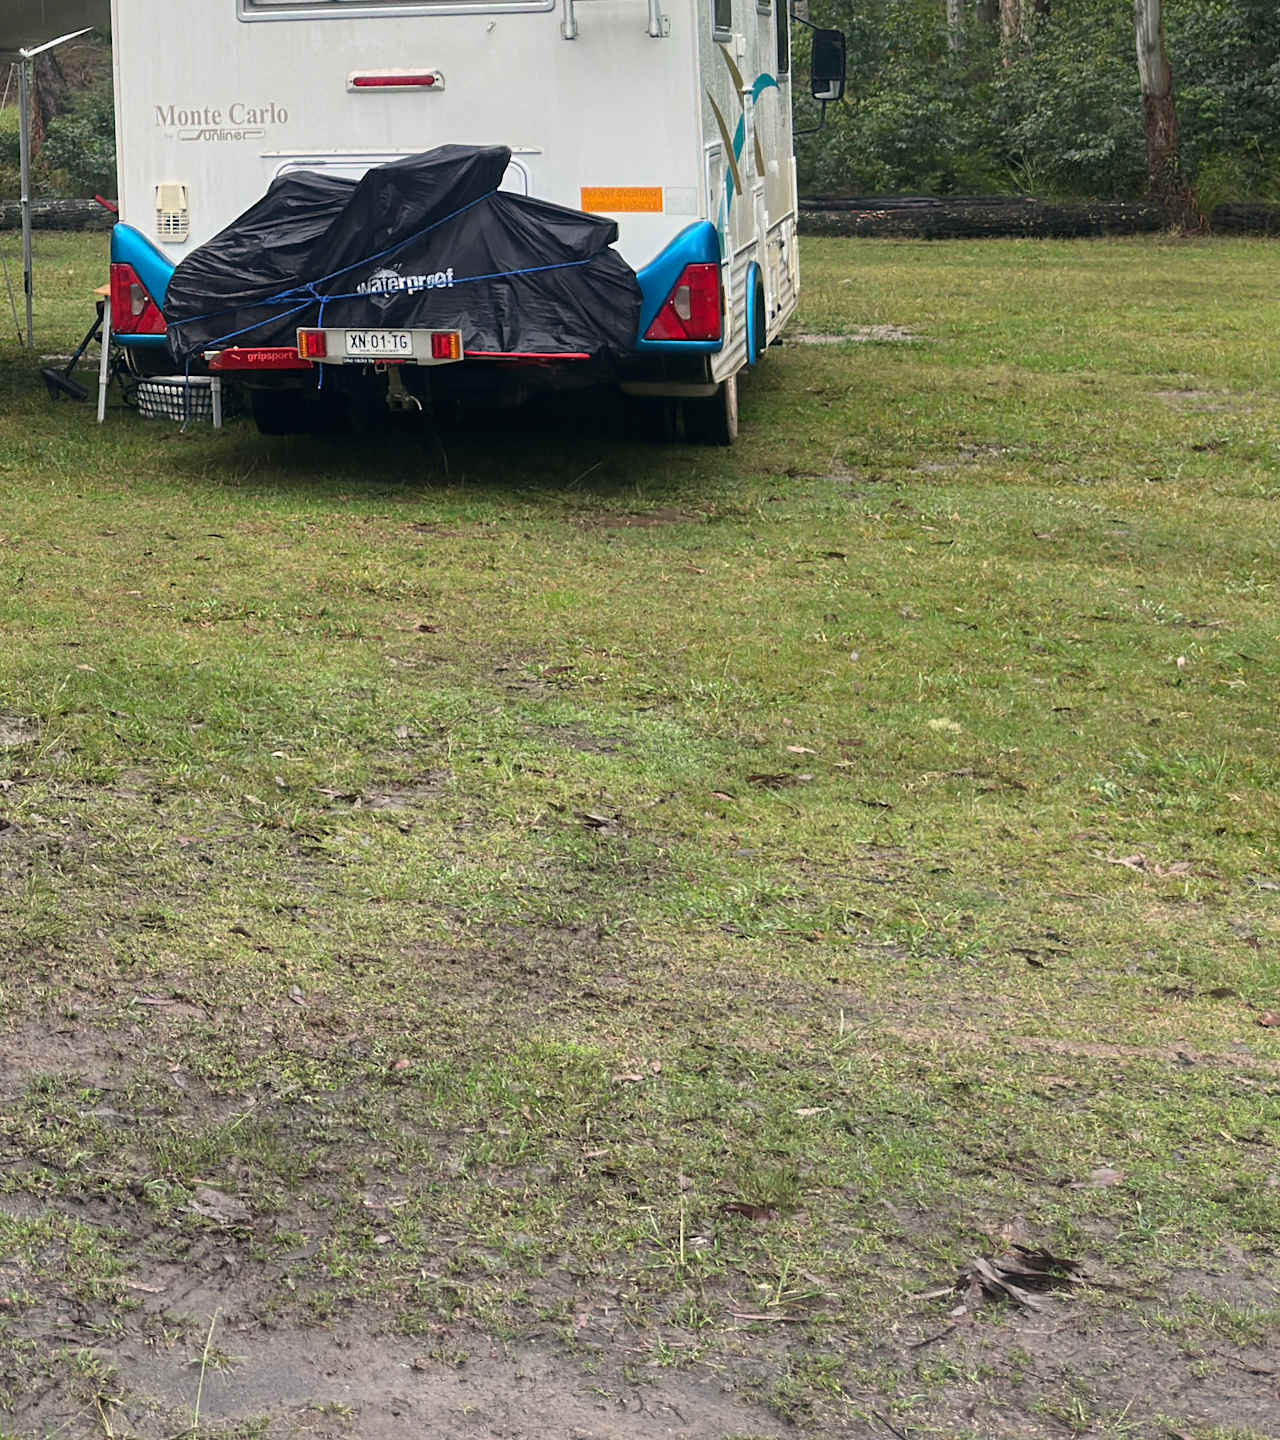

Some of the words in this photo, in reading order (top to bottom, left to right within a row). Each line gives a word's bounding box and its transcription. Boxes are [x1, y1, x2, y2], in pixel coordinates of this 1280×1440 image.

[154, 103, 222, 127] Monte
[228, 102, 289, 125] Carlo
[356, 267, 455, 299] waterproof
[247, 351, 294, 362] gripsport
